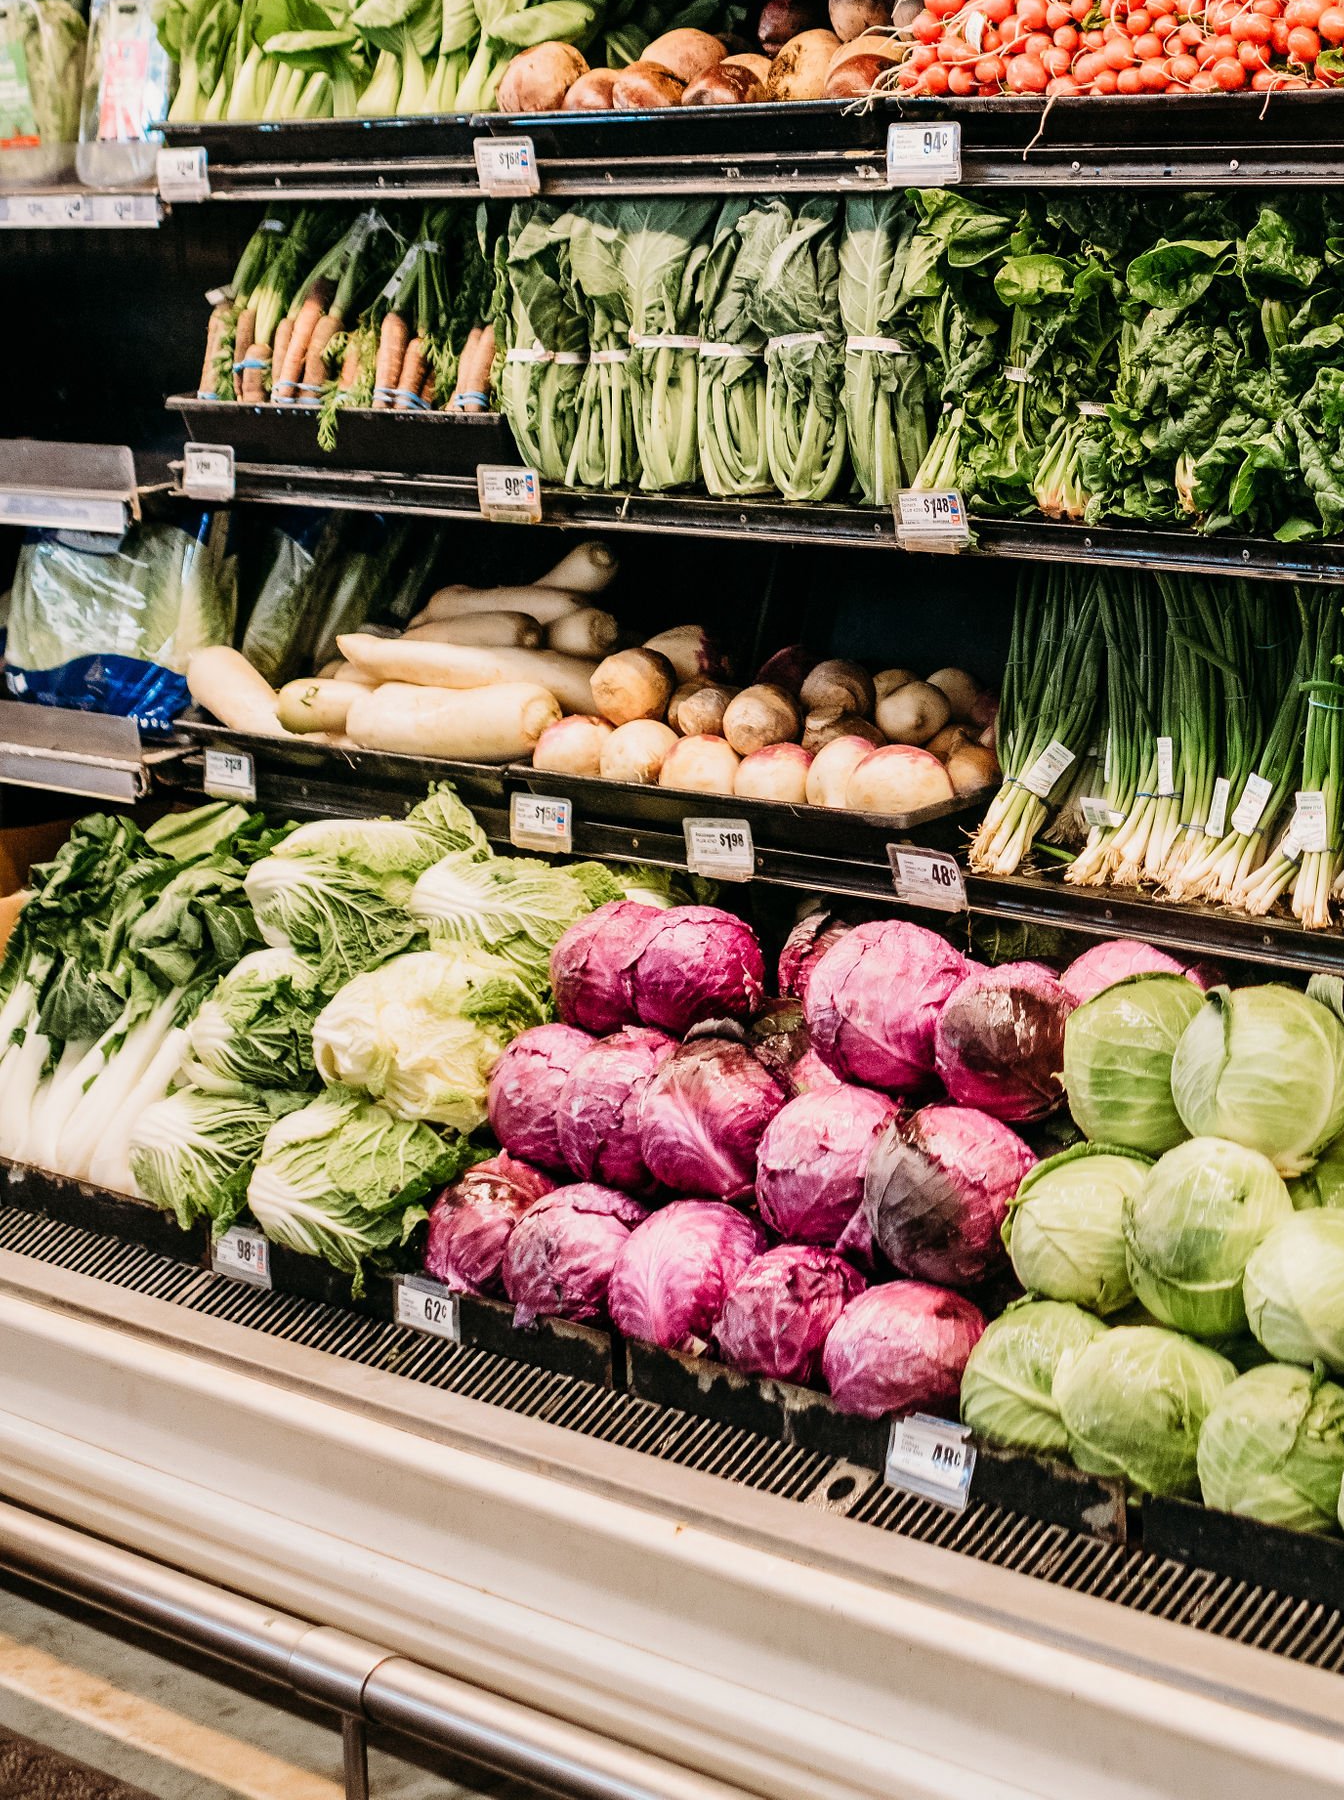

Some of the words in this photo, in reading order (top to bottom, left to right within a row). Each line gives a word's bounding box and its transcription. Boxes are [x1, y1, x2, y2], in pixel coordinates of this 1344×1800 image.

[924, 132, 948, 154] 94¢
[719, 833, 744, 852] $198
[932, 864, 956, 886] 48¢
[237, 1239, 256, 1261] 98¢
[425, 1298, 447, 1323] 62¢
